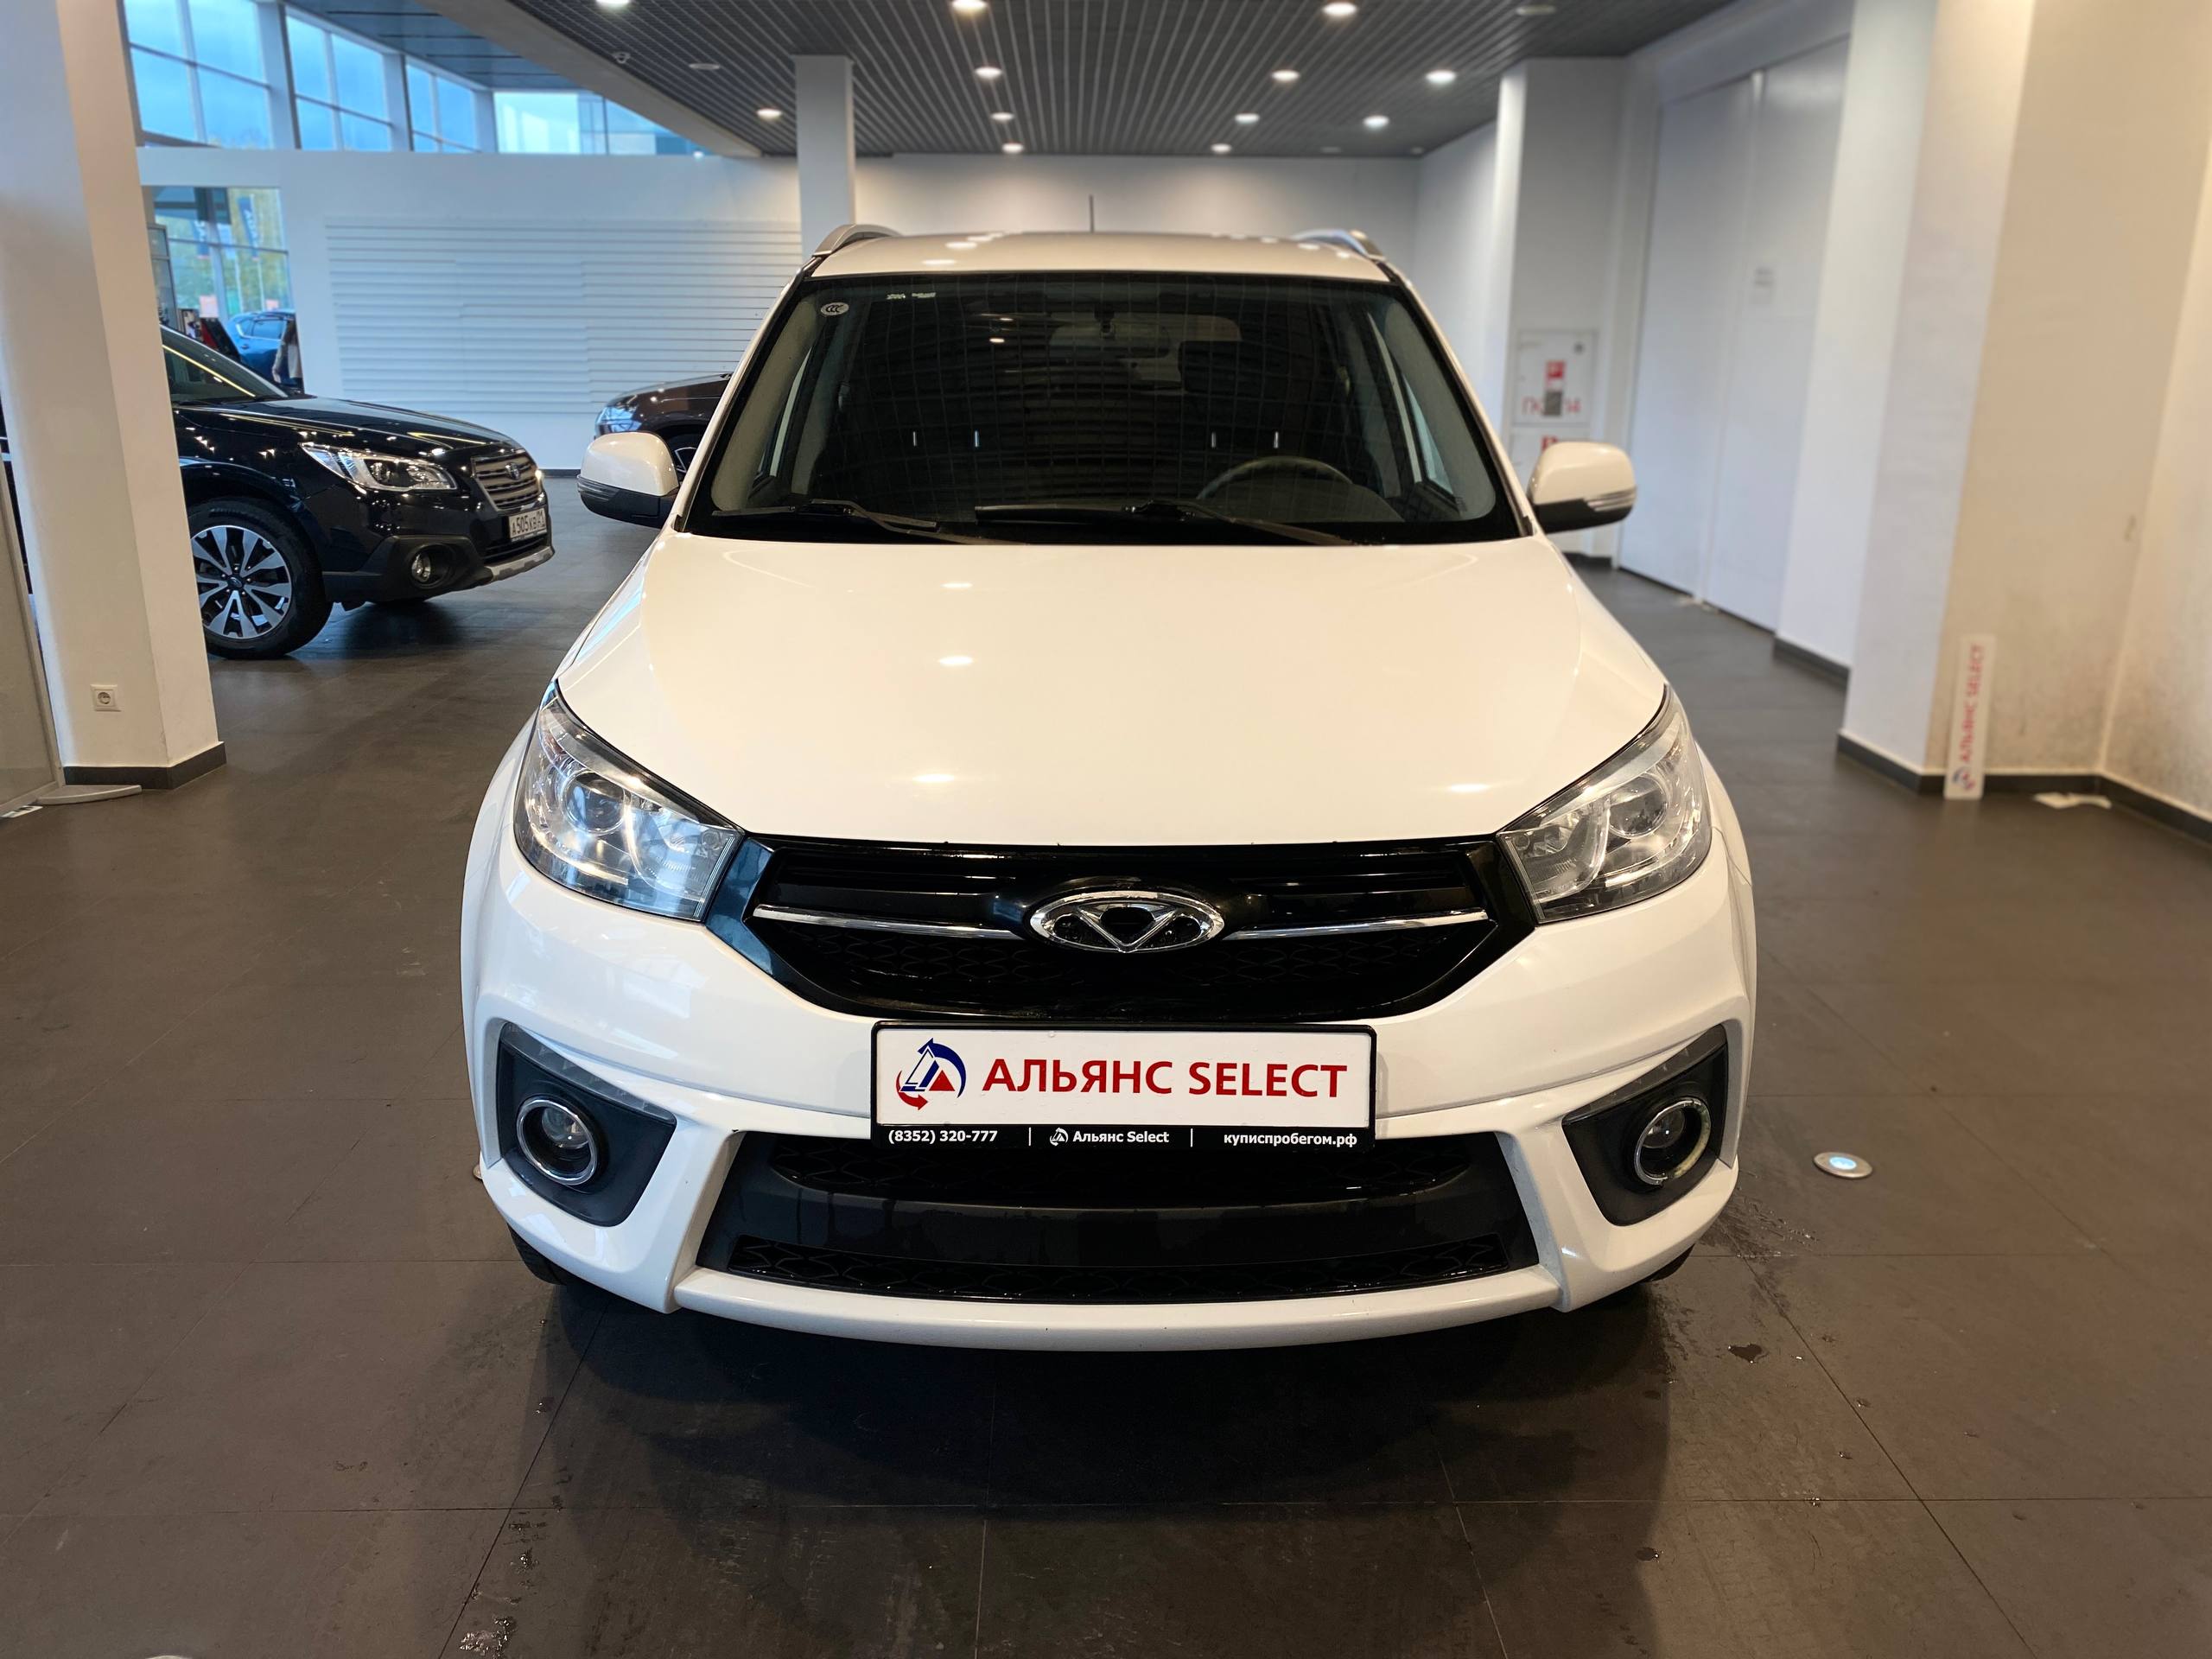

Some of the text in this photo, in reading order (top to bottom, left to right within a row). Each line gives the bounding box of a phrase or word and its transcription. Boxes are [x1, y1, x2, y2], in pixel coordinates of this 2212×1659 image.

[982, 1058, 1347, 1097] АЛЬЯНС SELECT
[888, 1129, 997, 1143] (8352) 320-777
[1072, 1130, 1169, 1142] Альянс Select
[1224, 1131, 1357, 1147] куписпробегом.рф
